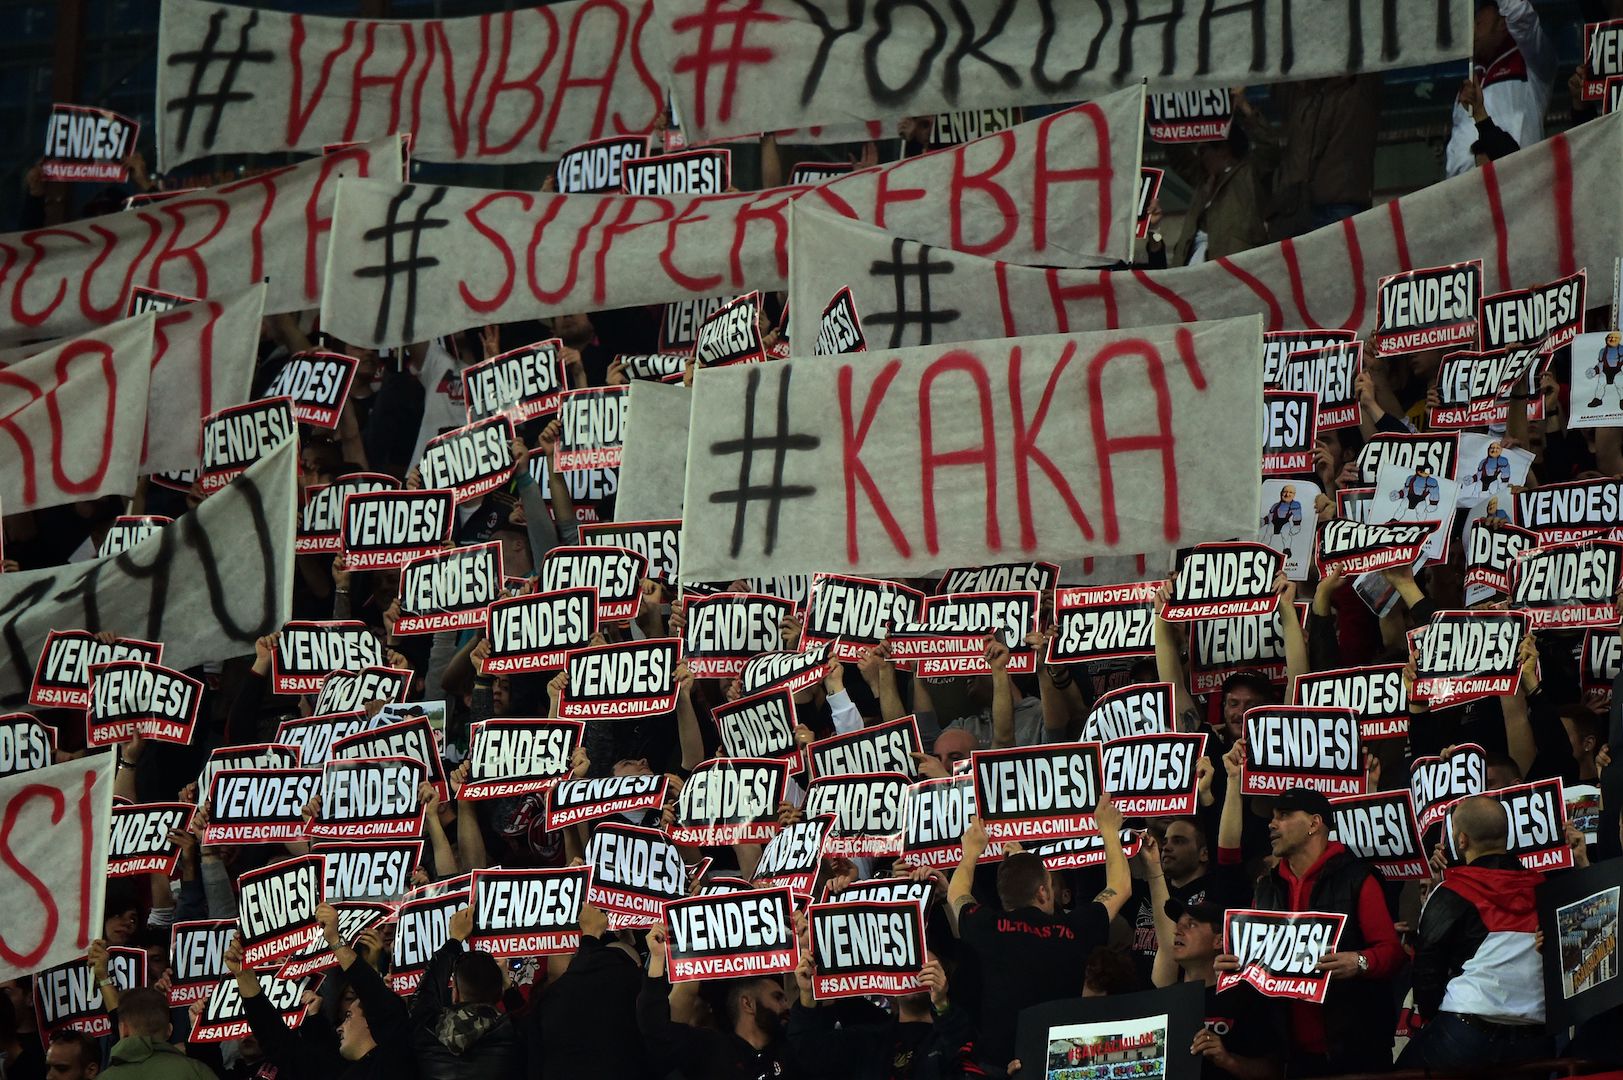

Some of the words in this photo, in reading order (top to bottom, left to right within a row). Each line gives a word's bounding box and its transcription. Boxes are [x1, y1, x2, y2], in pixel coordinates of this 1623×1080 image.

[45, 112, 129, 160] VENDESI
[627, 156, 722, 195] VENDESI
[1383, 270, 1474, 331] VENDESI
[1485, 280, 1580, 346] VENDESI
[699, 302, 757, 363] VENDESI
[1380, 326, 1475, 353] #SAVEACMILAN
[468, 349, 558, 416] VENDESI
[204, 406, 293, 468] VENDESI
[419, 423, 511, 490] VENDESI
[350, 498, 447, 547] VENDESI
[1323, 520, 1430, 555] VENDESI
[405, 552, 495, 613] VENDESI
[542, 553, 641, 598] VENDESI
[1174, 551, 1275, 601] VENDESI
[1517, 548, 1616, 607] VENDESI
[400, 607, 488, 632] #SAVEACMILA
[492, 595, 589, 653] VENDESI
[687, 602, 785, 653] VENDESI
[813, 583, 917, 641] VENDESI
[1167, 601, 1270, 620] #SAVEACMILAN
[279, 630, 383, 671] VENDESI
[890, 638, 984, 656] #SAVEACMILAN
[1197, 611, 1284, 665] VENDES
[1423, 621, 1520, 674] VENDESI
[94, 669, 193, 720] VENDESI
[569, 648, 672, 698] VENDESI
[564, 699, 670, 716] #SAVEACMILAN
[719, 698, 794, 760] VENDESI
[1079, 691, 1166, 743] ENDESI
[471, 728, 573, 779] VENDESI
[1247, 716, 1359, 771] VENDESI
[322, 764, 420, 821] VENDESI
[555, 774, 663, 807] VENDESI
[678, 767, 779, 823] VENDESI
[978, 752, 1096, 815] VENDESI
[315, 821, 415, 835] #SAVEACMILAN
[552, 796, 655, 826] #SAVEACMILAN
[984, 817, 1098, 841] #SAVEACMILAN
[325, 850, 412, 899] ENDESI
[585, 832, 688, 897] VENDESI
[239, 865, 317, 941] VENDESI
[477, 877, 583, 930] VENDESI
[668, 897, 787, 953] VENDESI
[474, 933, 581, 956] #SAVEACMILAN
[676, 954, 791, 977] #SAVEACMILAN
[814, 911, 916, 969] VENDESI
[1231, 920, 1333, 975] VENDESI
[820, 975, 921, 994] #SAVEACMILAN
